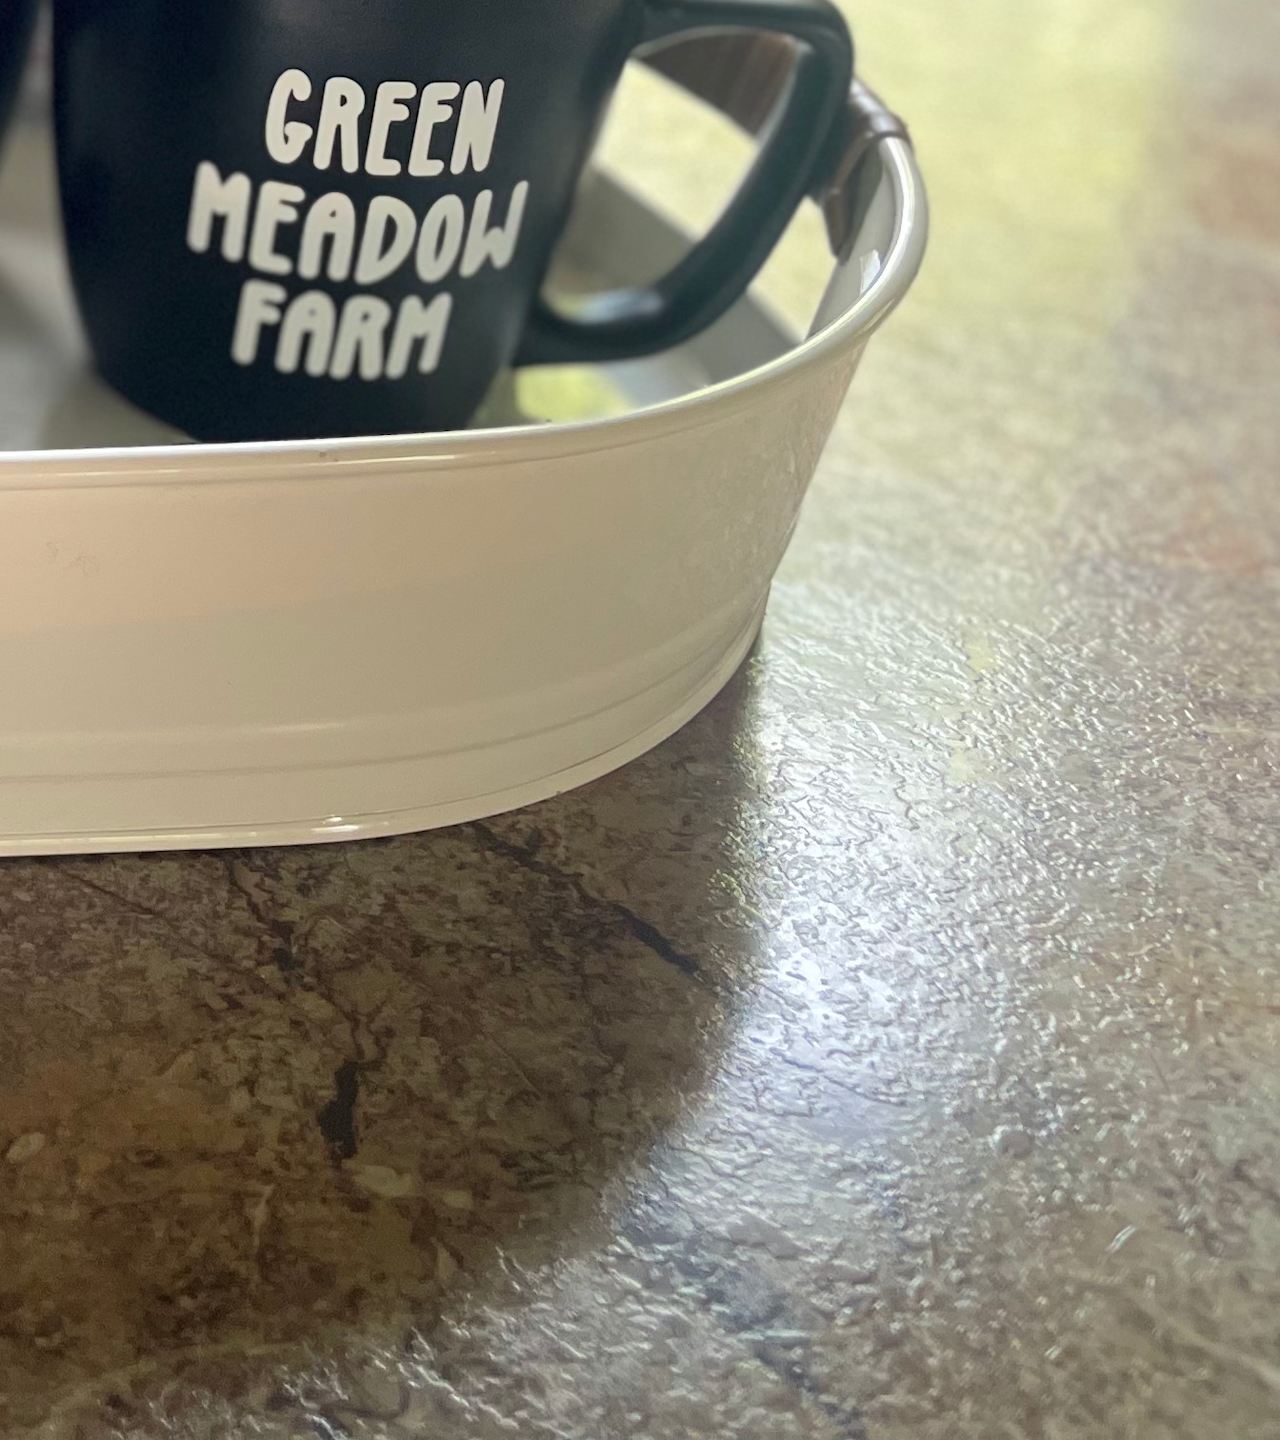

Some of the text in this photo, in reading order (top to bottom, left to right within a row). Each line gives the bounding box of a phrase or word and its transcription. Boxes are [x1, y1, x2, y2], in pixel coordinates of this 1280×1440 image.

[264, 68, 506, 177] GREEN
[185, 160, 530, 286] MEADOW
[230, 279, 454, 381] FARM
